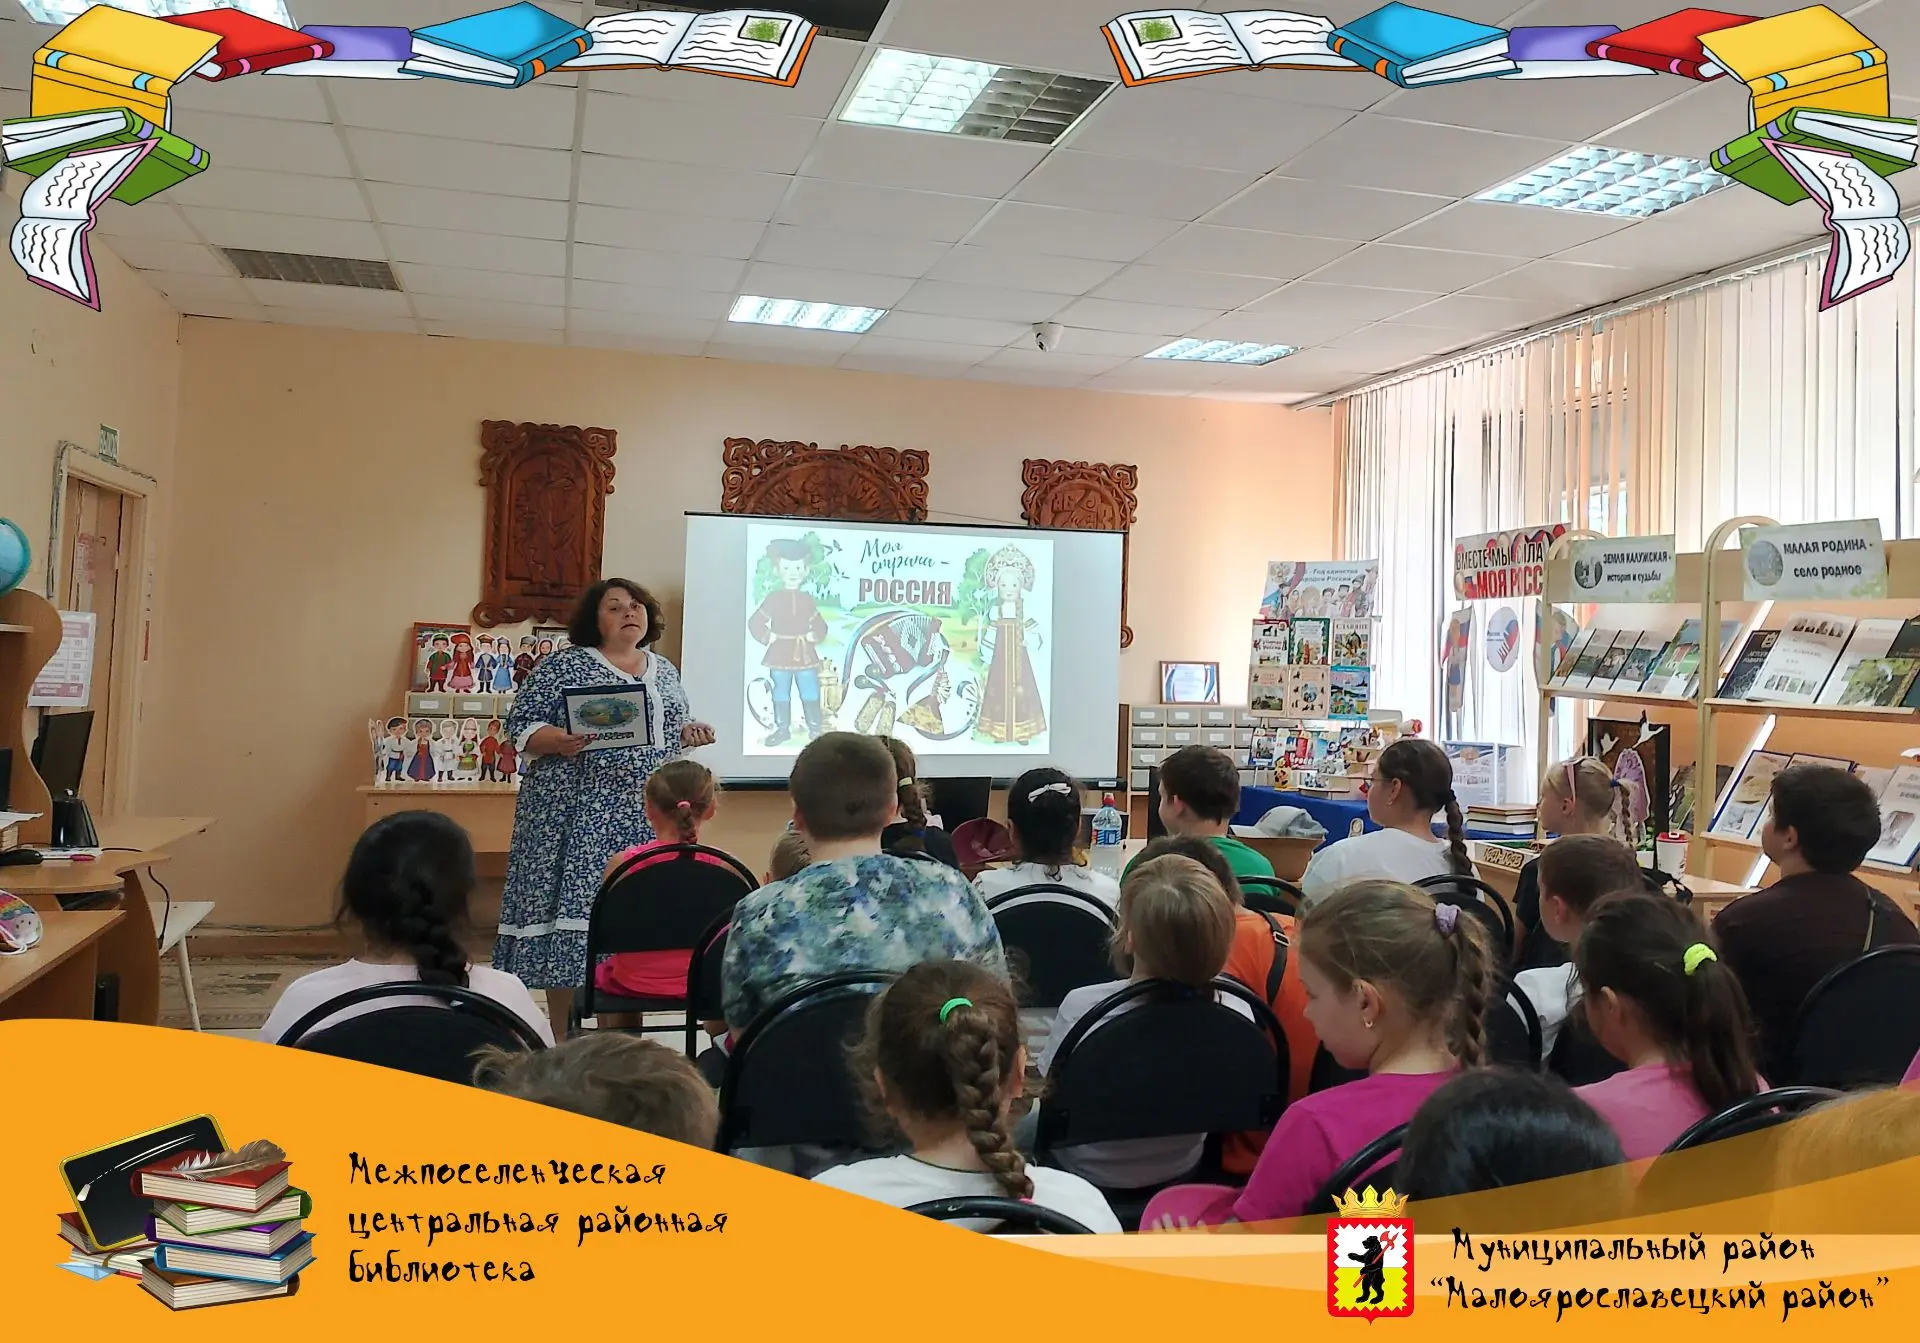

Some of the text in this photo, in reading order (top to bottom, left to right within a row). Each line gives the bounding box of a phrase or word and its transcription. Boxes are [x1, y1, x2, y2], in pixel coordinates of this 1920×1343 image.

[860, 538, 903, 563] Моя
[1456, 549, 1488, 571] ВМЕСТЕ
[1491, 545, 1511, 567] МЫ
[1603, 552, 1625, 565] ЗЕМЛЯ
[1626, 550, 1668, 565] КАЛУЖСКАЯ
[1783, 541, 1820, 555] МАЛАЯ
[1822, 538, 1868, 554] РОДИНА
[872, 555, 936, 578] страна
[1607, 572, 1632, 583] история
[1638, 568, 1662, 584] судьбы
[1793, 564, 1862, 580] село родное
[859, 578, 952, 605] РОССИЯ
[1476, 564, 1543, 599] МОЯ РОСС
